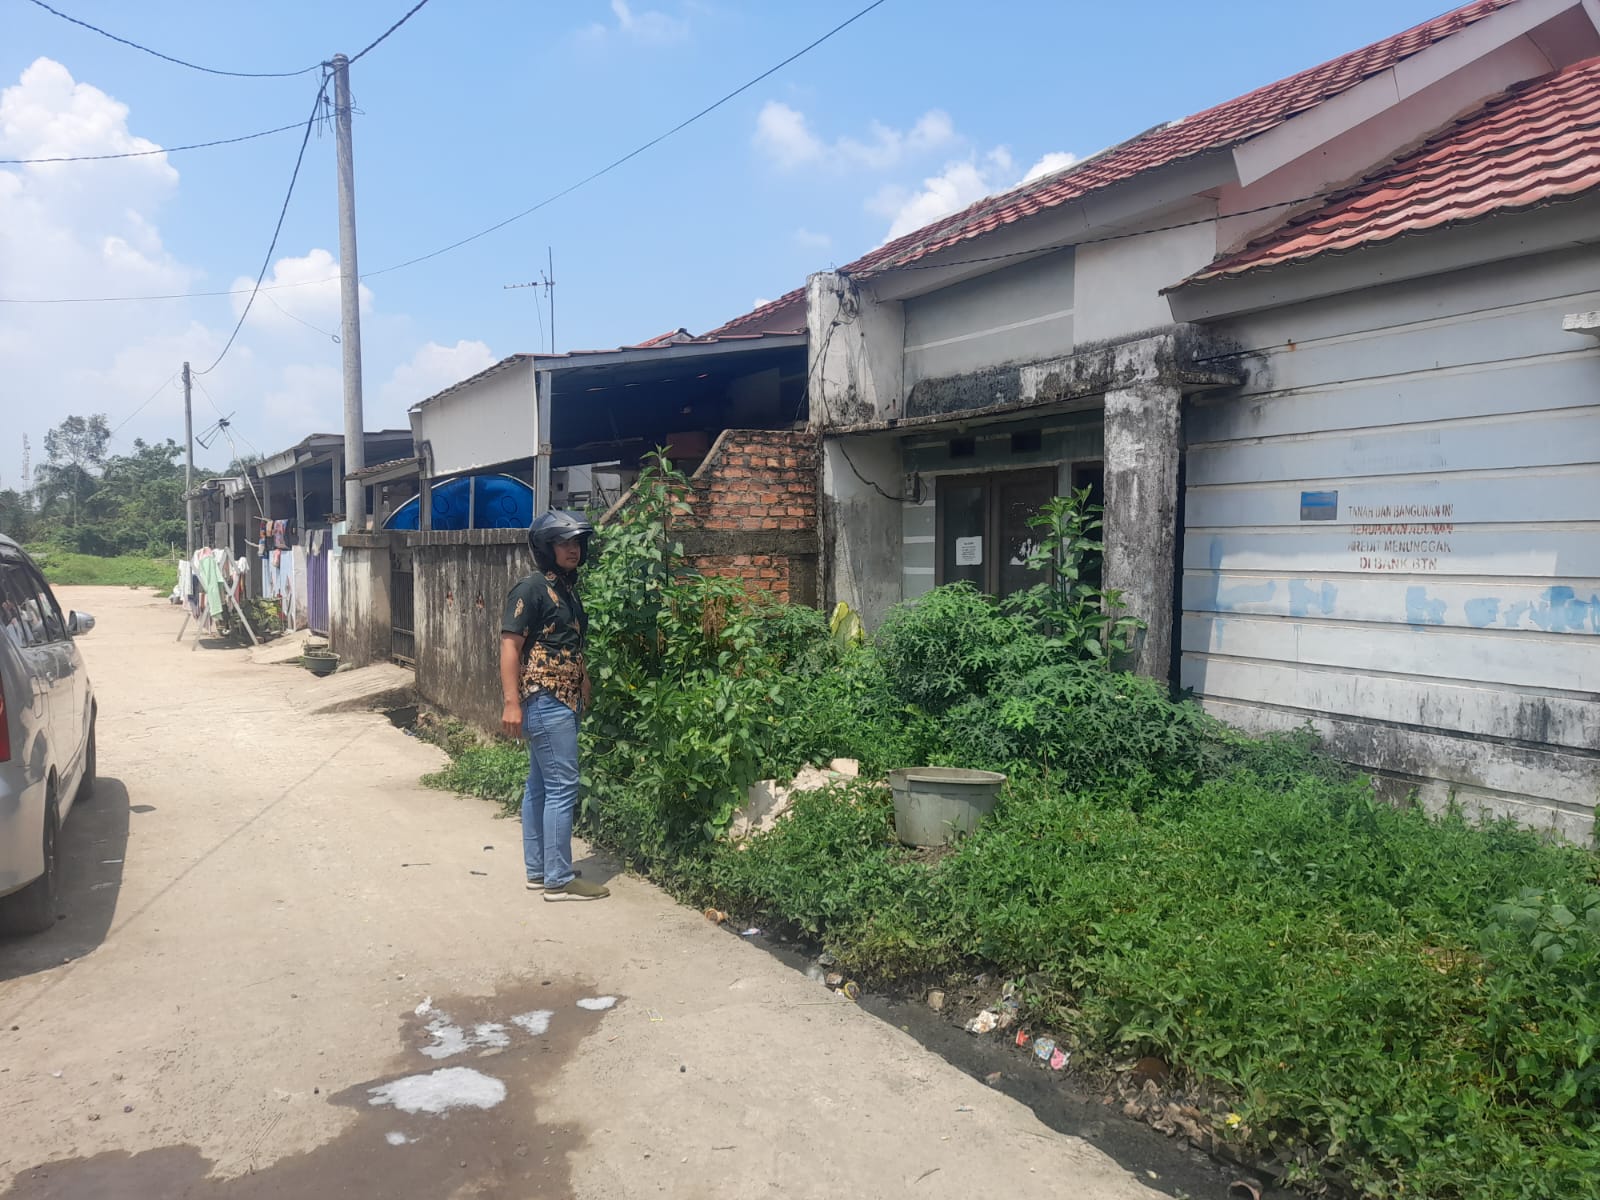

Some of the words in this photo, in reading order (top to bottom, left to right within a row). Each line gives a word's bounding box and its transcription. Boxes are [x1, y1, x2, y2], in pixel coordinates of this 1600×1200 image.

[1348, 505, 1373, 518] TANAH
[1375, 505, 1391, 518] DAN
[1394, 504, 1440, 518] BANGUNAN
[1442, 503, 1454, 517] INI
[1360, 557, 1371, 569] DI
[1374, 557, 1408, 569] BANK
[1412, 557, 1438, 570] BTN
